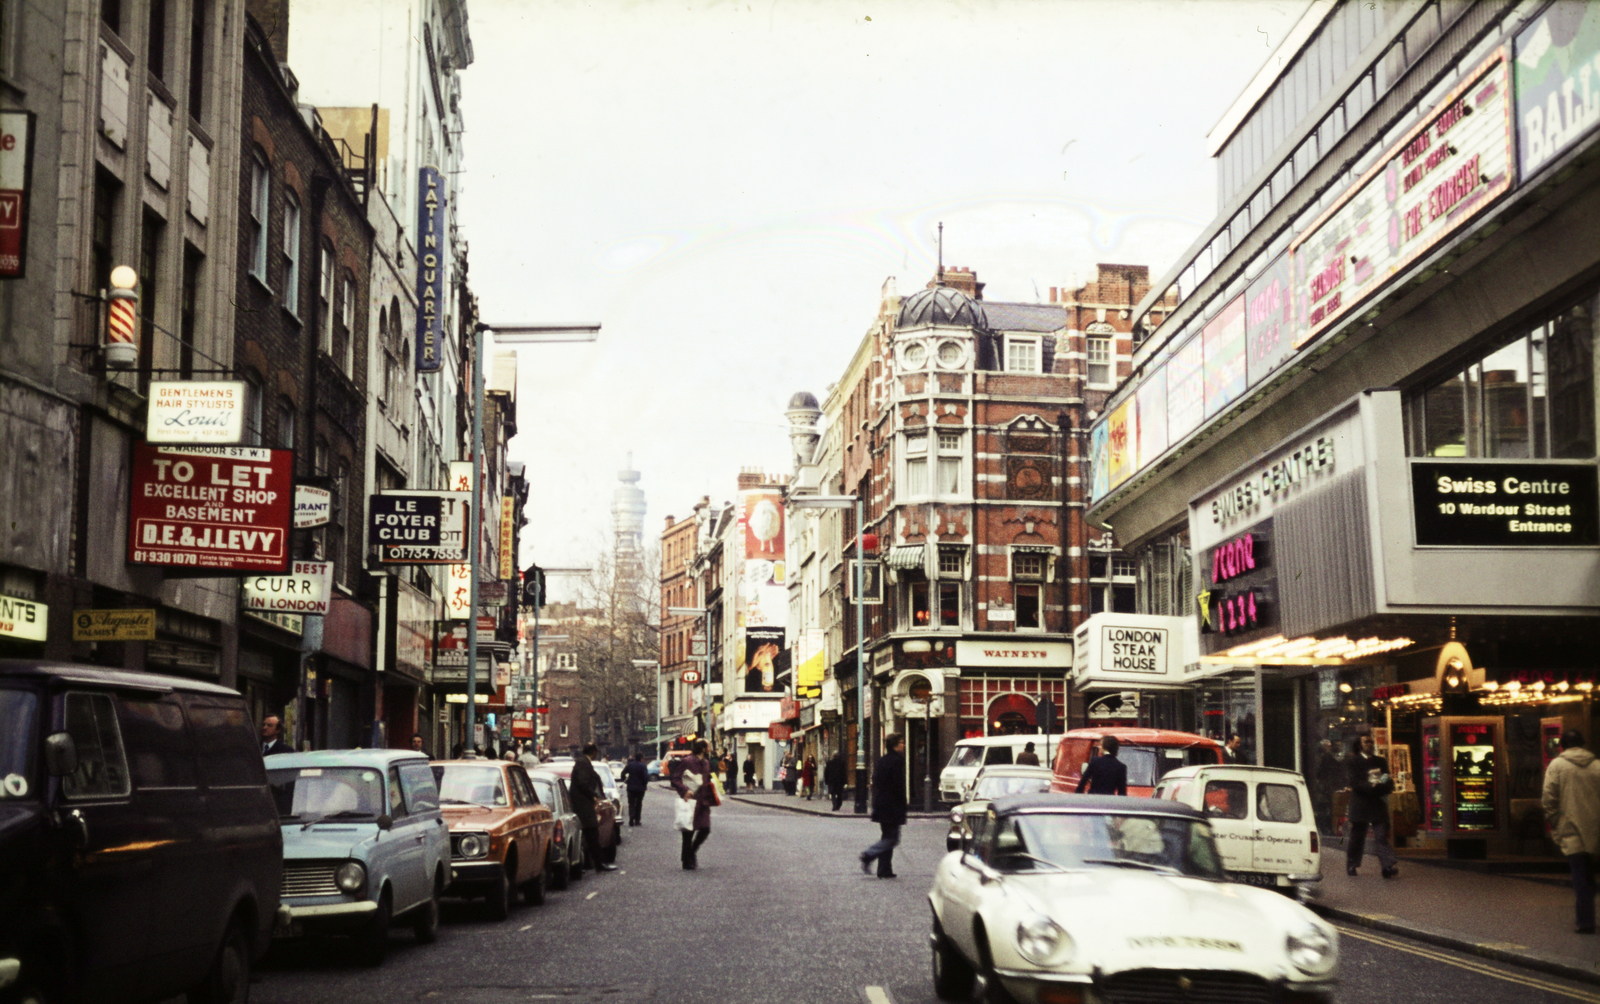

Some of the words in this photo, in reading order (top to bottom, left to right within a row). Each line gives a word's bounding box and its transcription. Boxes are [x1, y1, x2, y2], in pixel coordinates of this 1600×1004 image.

[1403, 202, 1422, 242] THE
[1427, 153, 1480, 223] EXORCIST
[424, 173, 437, 249] LATIN
[423, 253, 436, 361] QUARTER
[160, 388, 233, 398] GENTLEMENS
[156, 399, 182, 408] HAIR
[186, 399, 235, 409] STYLISTS
[153, 459, 194, 483] TO
[210, 463, 272, 489] LET
[1212, 481, 1257, 525] SWISS
[1262, 437, 1333, 497] CENTRE
[1438, 476, 1497, 494] Swiss
[1504, 477, 1570, 494] Centre
[144, 482, 228, 502] EXCELLENT
[232, 488, 277, 505] SHOP
[395, 500, 417, 512] LE
[1439, 502, 1456, 515] 10
[1459, 502, 1520, 516] Wardour
[1525, 503, 1571, 516] Street
[166, 504, 256, 523] BASEMENT
[375, 514, 436, 527] FOYER
[1509, 519, 1572, 533] Entrance
[379, 528, 430, 540] CLUB
[172, 552, 197, 564] 1070
[432, 548, 462, 559] 7555
[295, 563, 327, 575] BEST
[251, 597, 265, 608] IN
[270, 598, 326, 612] LONDON
[1108, 629, 1162, 643] LONDON
[983, 650, 1047, 658] WATNEYS
[1113, 643, 1156, 656] STEAK
[1114, 657, 1156, 670] HOUSE
[1266, 835, 1303, 845] Operators
